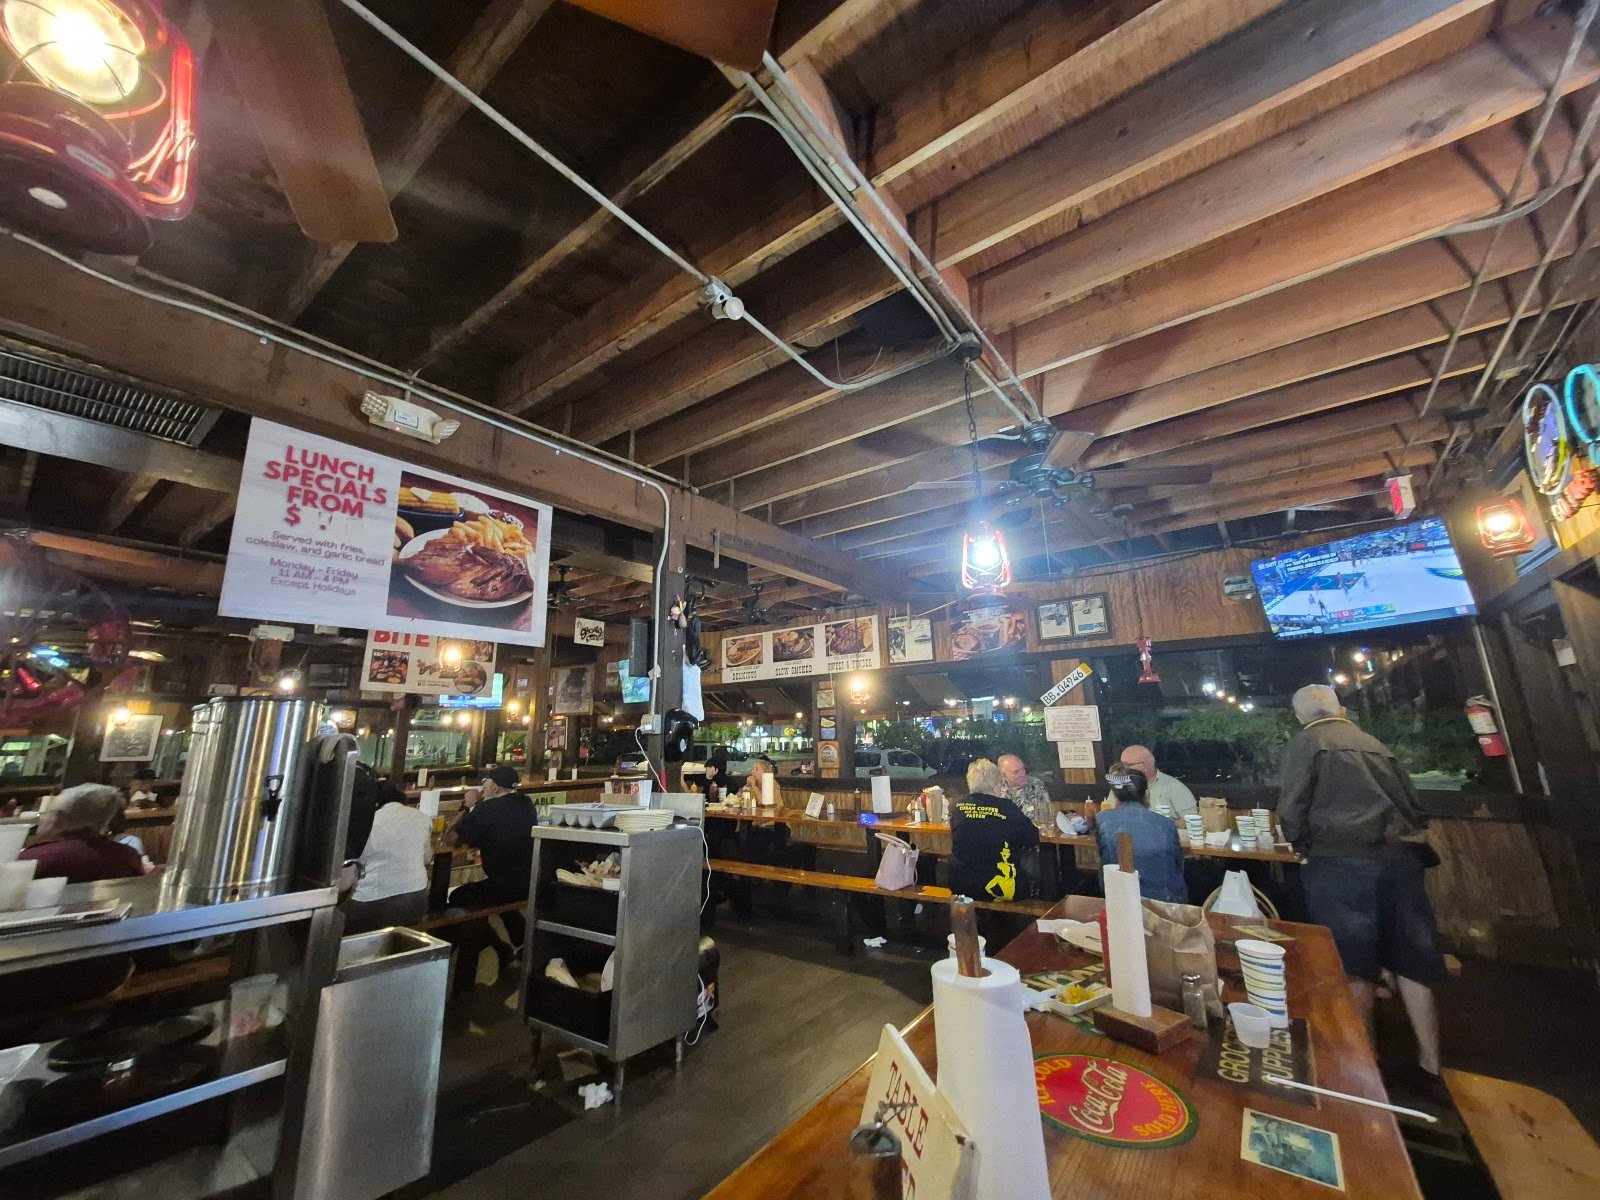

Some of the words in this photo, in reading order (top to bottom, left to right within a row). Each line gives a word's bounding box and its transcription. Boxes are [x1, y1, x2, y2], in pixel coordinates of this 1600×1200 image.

[286, 444, 374, 483] LUNCH
[263, 460, 387, 505] SPECIALS
[287, 485, 364, 518] FROM
[245, 536, 298, 552] coleslaw,
[301, 546, 322, 555] and
[324, 550, 353, 561] garlic
[355, 555, 385, 566] bread
[272, 530, 312, 544] Served
[315, 539, 338, 549] with
[269, 557, 315, 573] Monday
[326, 566, 359, 580] Friday
[279, 568, 290, 577] 11
[293, 570, 312, 580] AM
[322, 575, 330, 583] 4
[332, 576, 350, 585] PM
[270, 576, 310, 590] Except
[313, 582, 357, 596] Holidays
[886, 1060, 929, 1159] TABLE
[1068, 1060, 1128, 1134] Coca-Cola
[1133, 1114, 1177, 1136] SOLD
